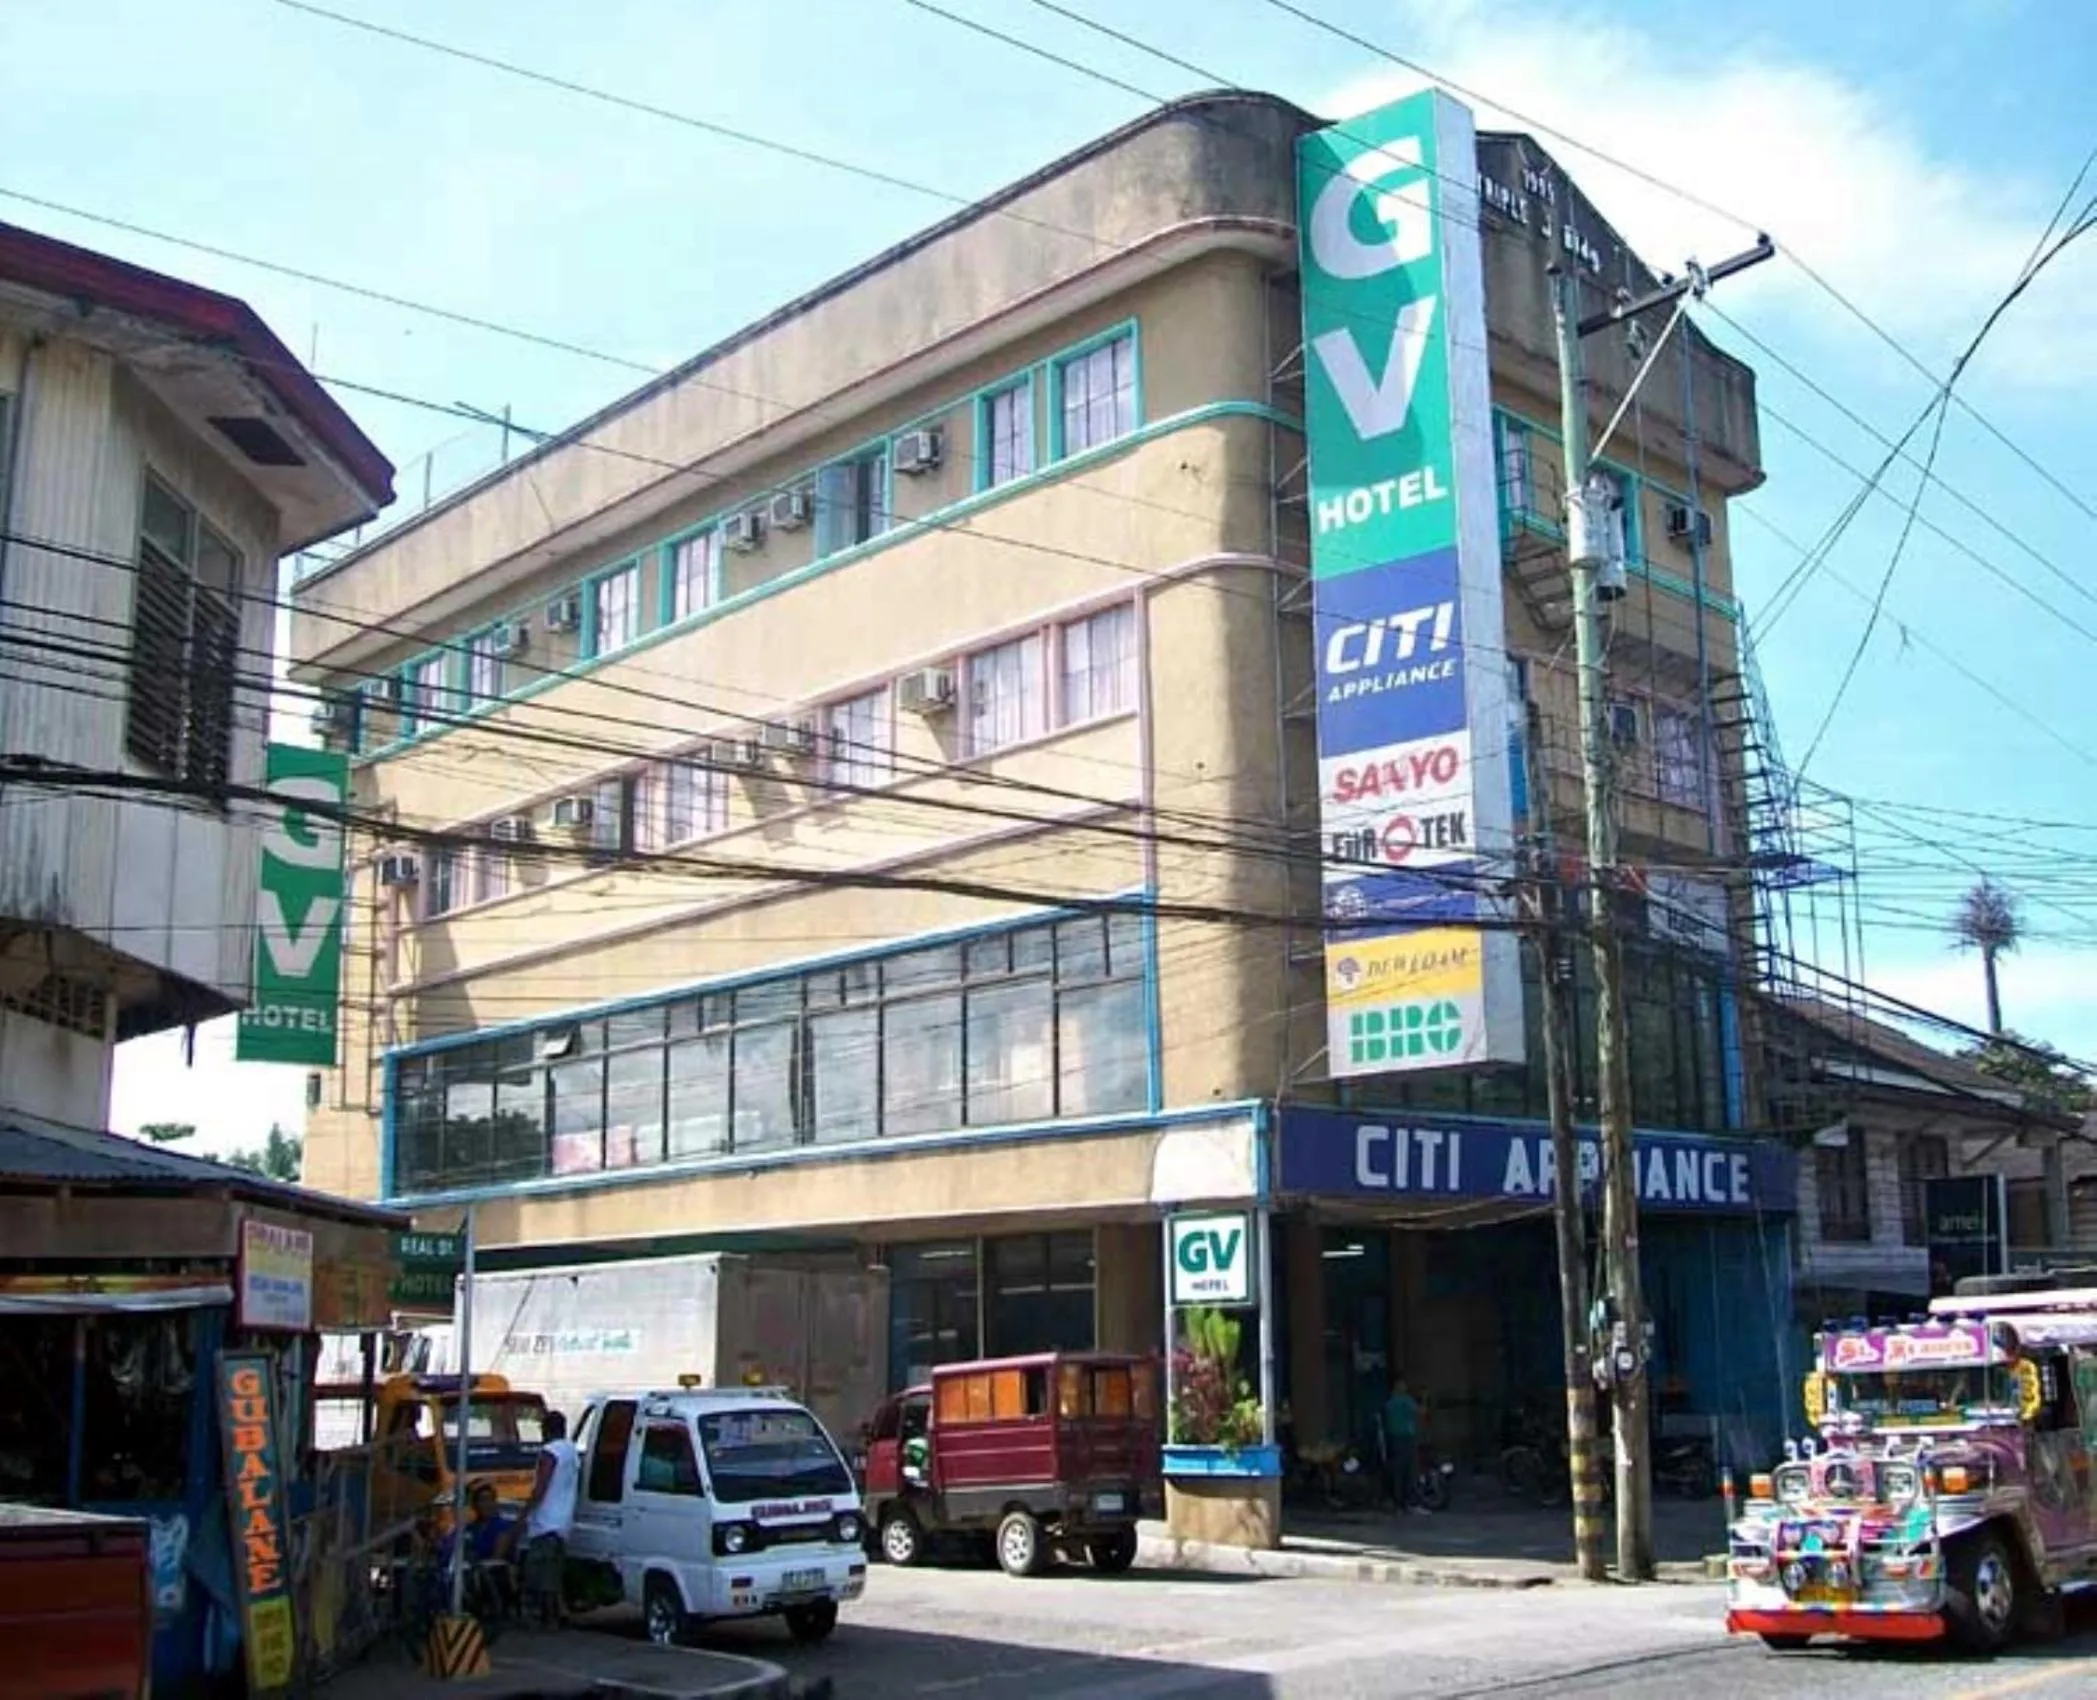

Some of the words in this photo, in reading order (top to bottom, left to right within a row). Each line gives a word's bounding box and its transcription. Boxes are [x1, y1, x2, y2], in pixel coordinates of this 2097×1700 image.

[1318, 464, 1449, 535] HOTEL
[1326, 600, 1454, 674] CITI
[1327, 657, 1457, 703] APPLIANCE
[1355, 1125, 1461, 1191] CITI
[1503, 1137, 1750, 1202] APPIANCE
[1178, 1228, 1242, 1273] GV
